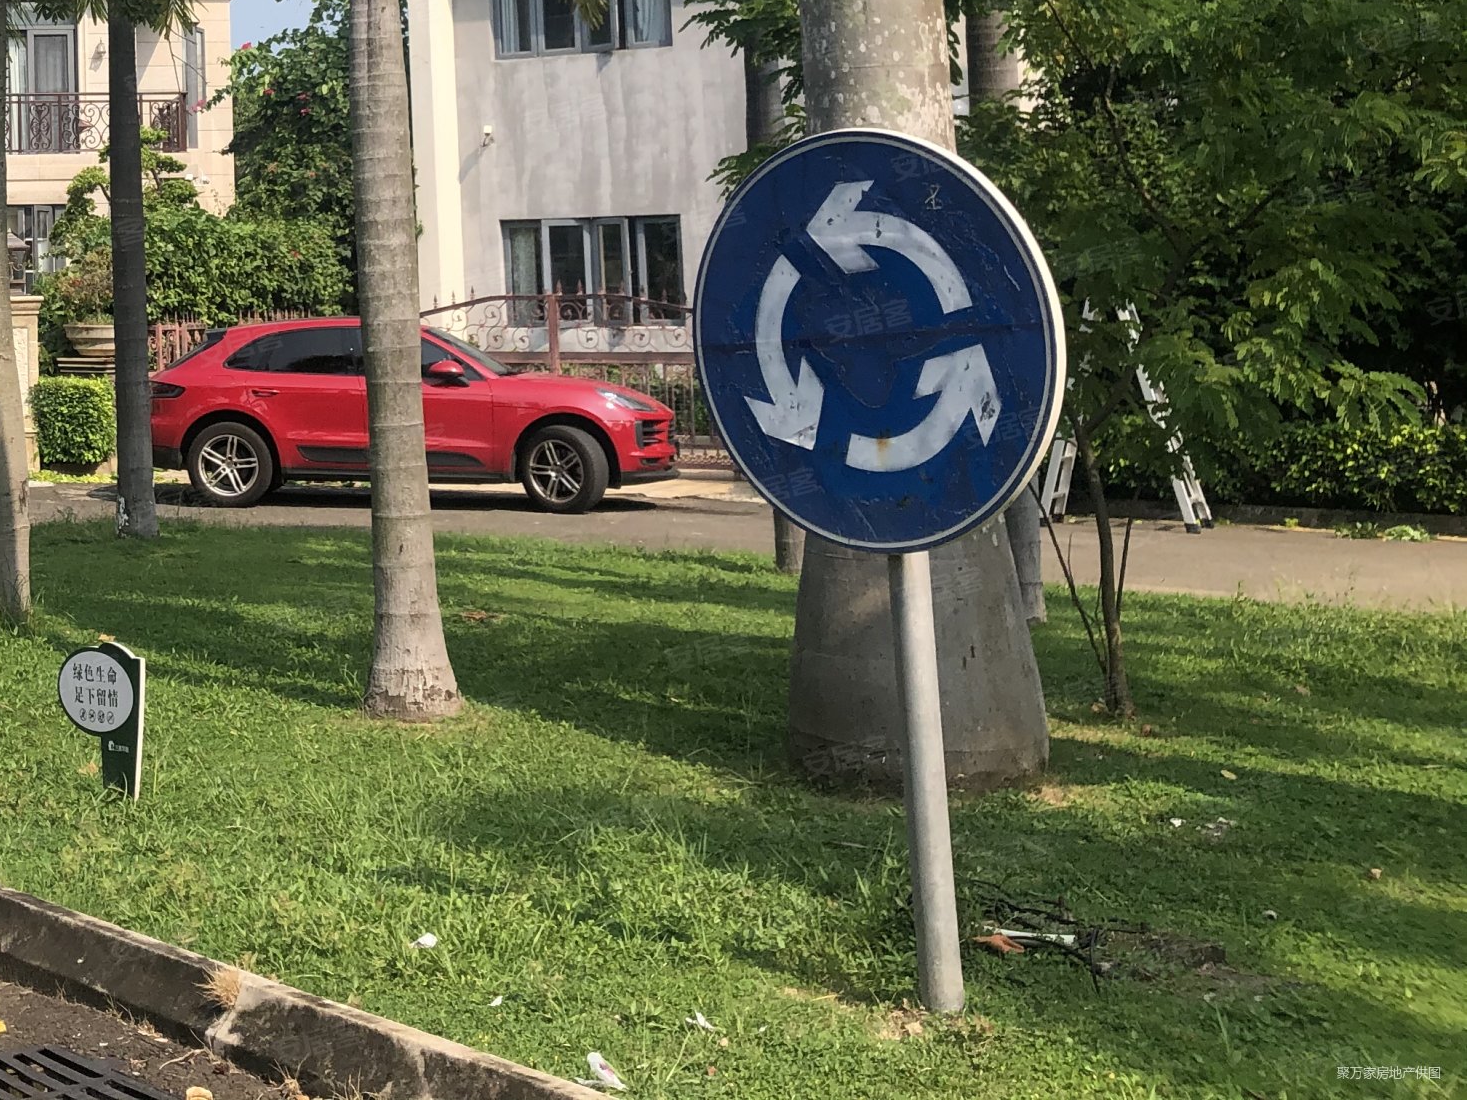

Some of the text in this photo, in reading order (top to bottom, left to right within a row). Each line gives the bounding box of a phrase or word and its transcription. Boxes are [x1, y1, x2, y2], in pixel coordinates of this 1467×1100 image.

[72, 663, 117, 685] 绿色生命
[74, 686, 118, 708] 足下留情
